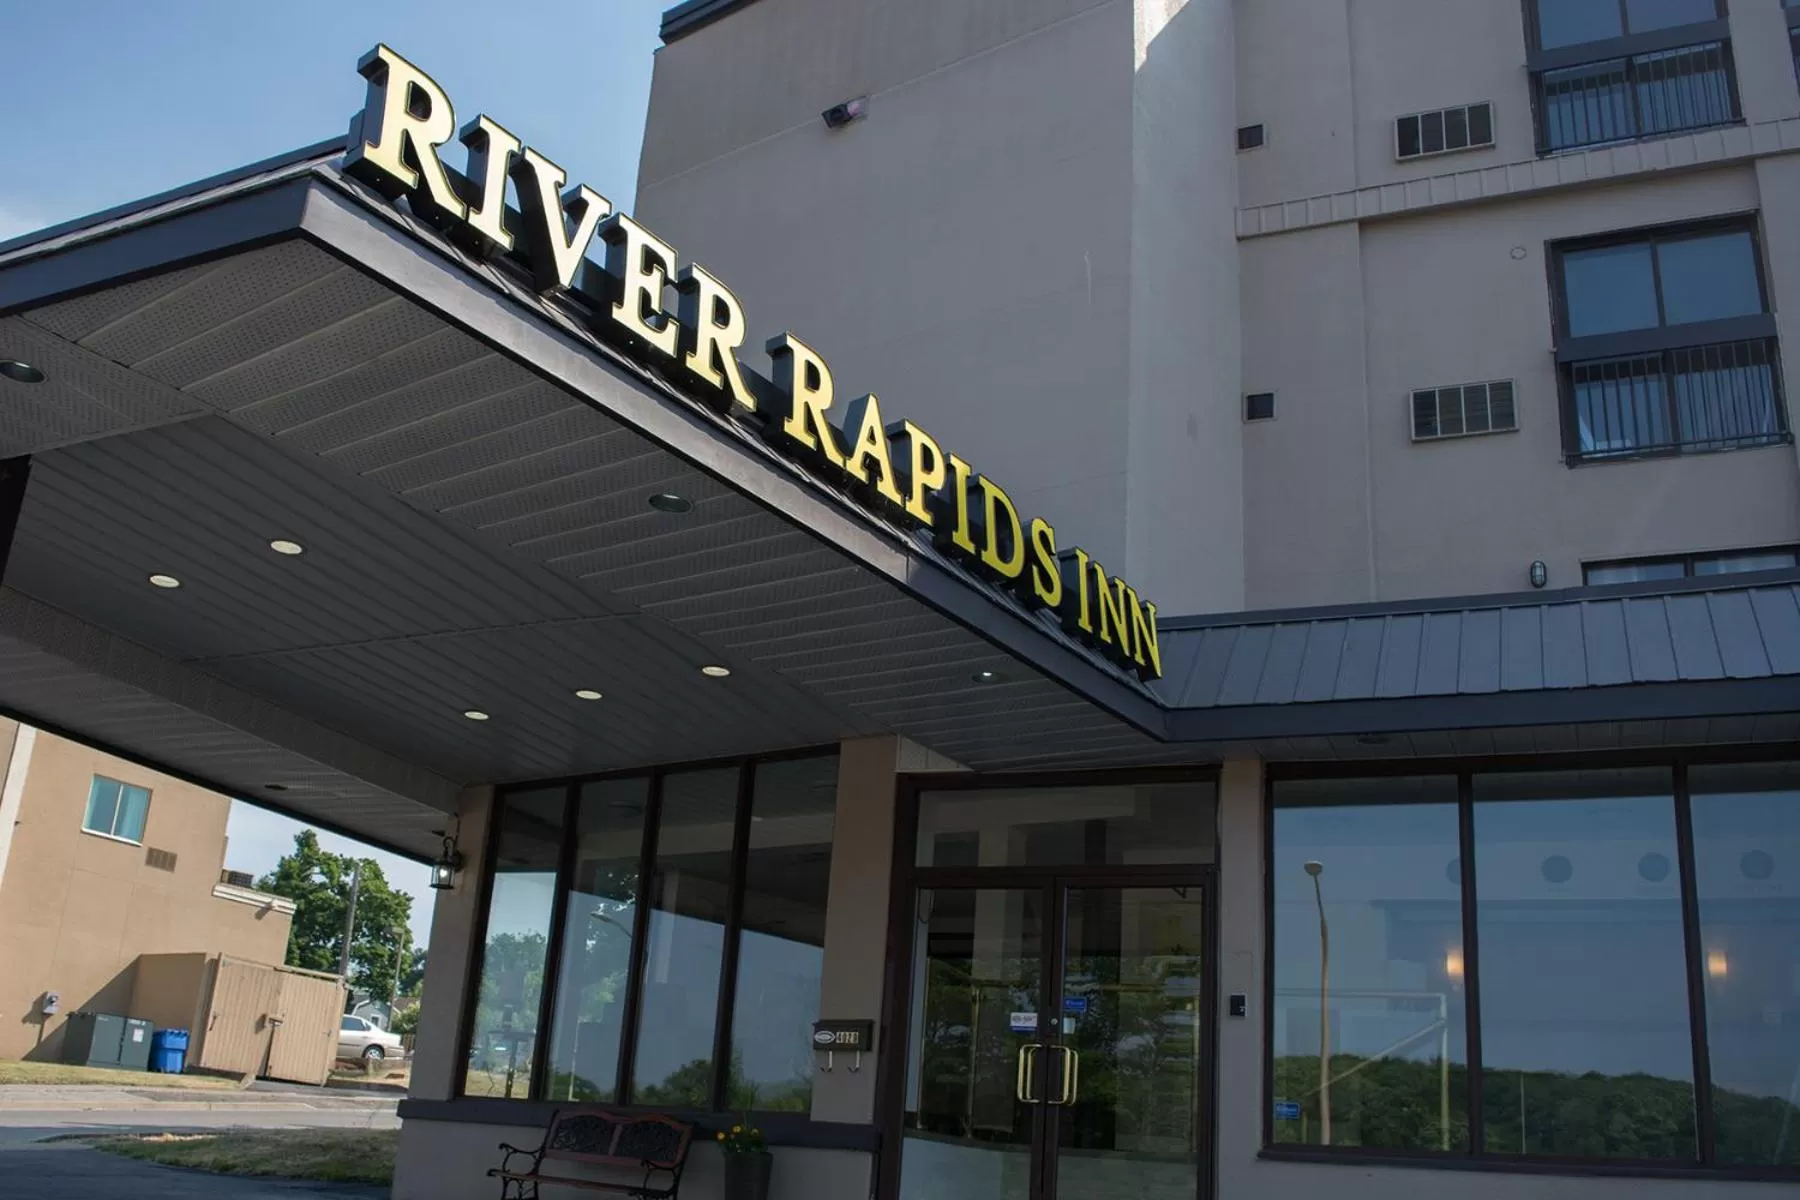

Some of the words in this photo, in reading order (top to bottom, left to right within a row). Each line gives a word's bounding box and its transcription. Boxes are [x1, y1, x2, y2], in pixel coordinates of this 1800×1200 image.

[361, 43, 758, 413] RIVER
[783, 332, 1063, 608] RAPIDS
[1072, 546, 1162, 679] INN
